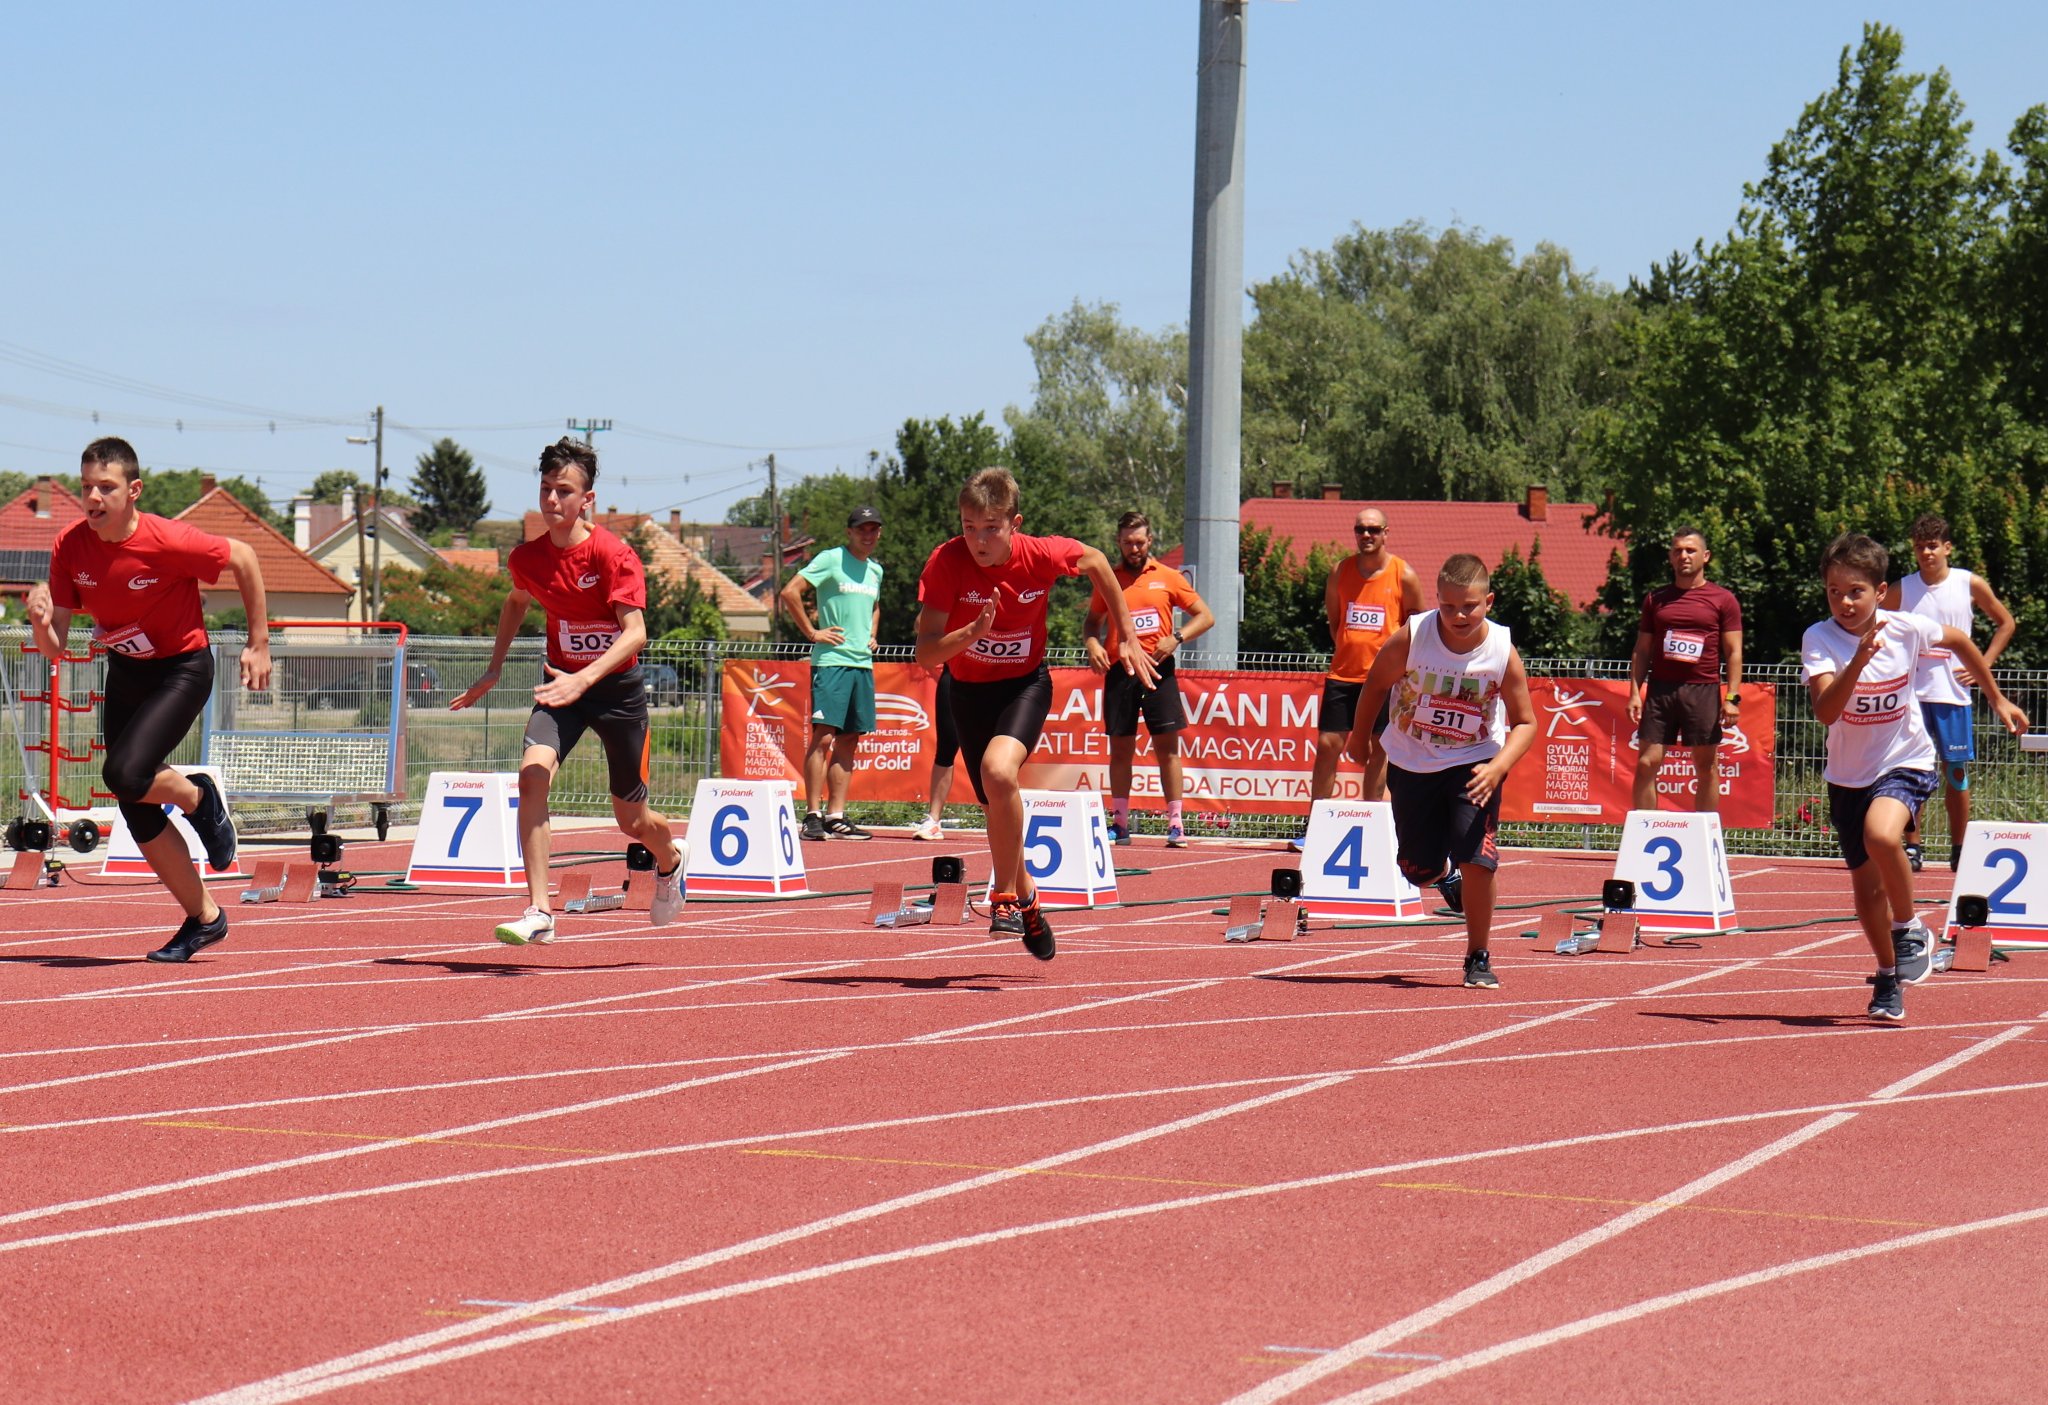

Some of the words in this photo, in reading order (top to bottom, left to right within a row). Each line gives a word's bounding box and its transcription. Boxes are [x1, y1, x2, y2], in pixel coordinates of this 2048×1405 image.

[1135, 616, 1154, 628] 05
[1351, 612, 1378, 624] 508
[113, 640, 140, 653] 01
[570, 634, 613, 652] 503
[975, 639, 1021, 656] 502
[1668, 641, 1697, 654] 509
[1180, 683, 1268, 727] VÁN
[1855, 693, 1898, 713] 510
[1431, 709, 1465, 729] 511
[746, 723, 785, 734] GYULAI
[1177, 736, 1297, 762] MAGYAR
[1546, 744, 1589, 755] GYULAI
[745, 757, 785, 767] MAGYAR
[874, 755, 911, 770] Gold
[1546, 765, 1588, 773] MEMORIAL
[452, 780, 485, 790] polanik
[1076, 772, 1092, 790] A
[1546, 780, 1588, 790] MAGYAR
[720, 788, 754, 797] polanik
[1033, 799, 1067, 808] polanik
[1337, 809, 1372, 818] polanik
[443, 796, 483, 858] 7
[1652, 820, 1689, 829] polanik
[710, 804, 750, 866] 6
[779, 804, 794, 866] 6
[1993, 831, 2032, 840] polanik
[1023, 815, 1063, 878] 5
[1091, 816, 1105, 878] 5
[1323, 826, 1369, 889] 4
[1641, 836, 1685, 901] 3
[1713, 837, 1726, 902] 3
[1984, 848, 2028, 914] 2
